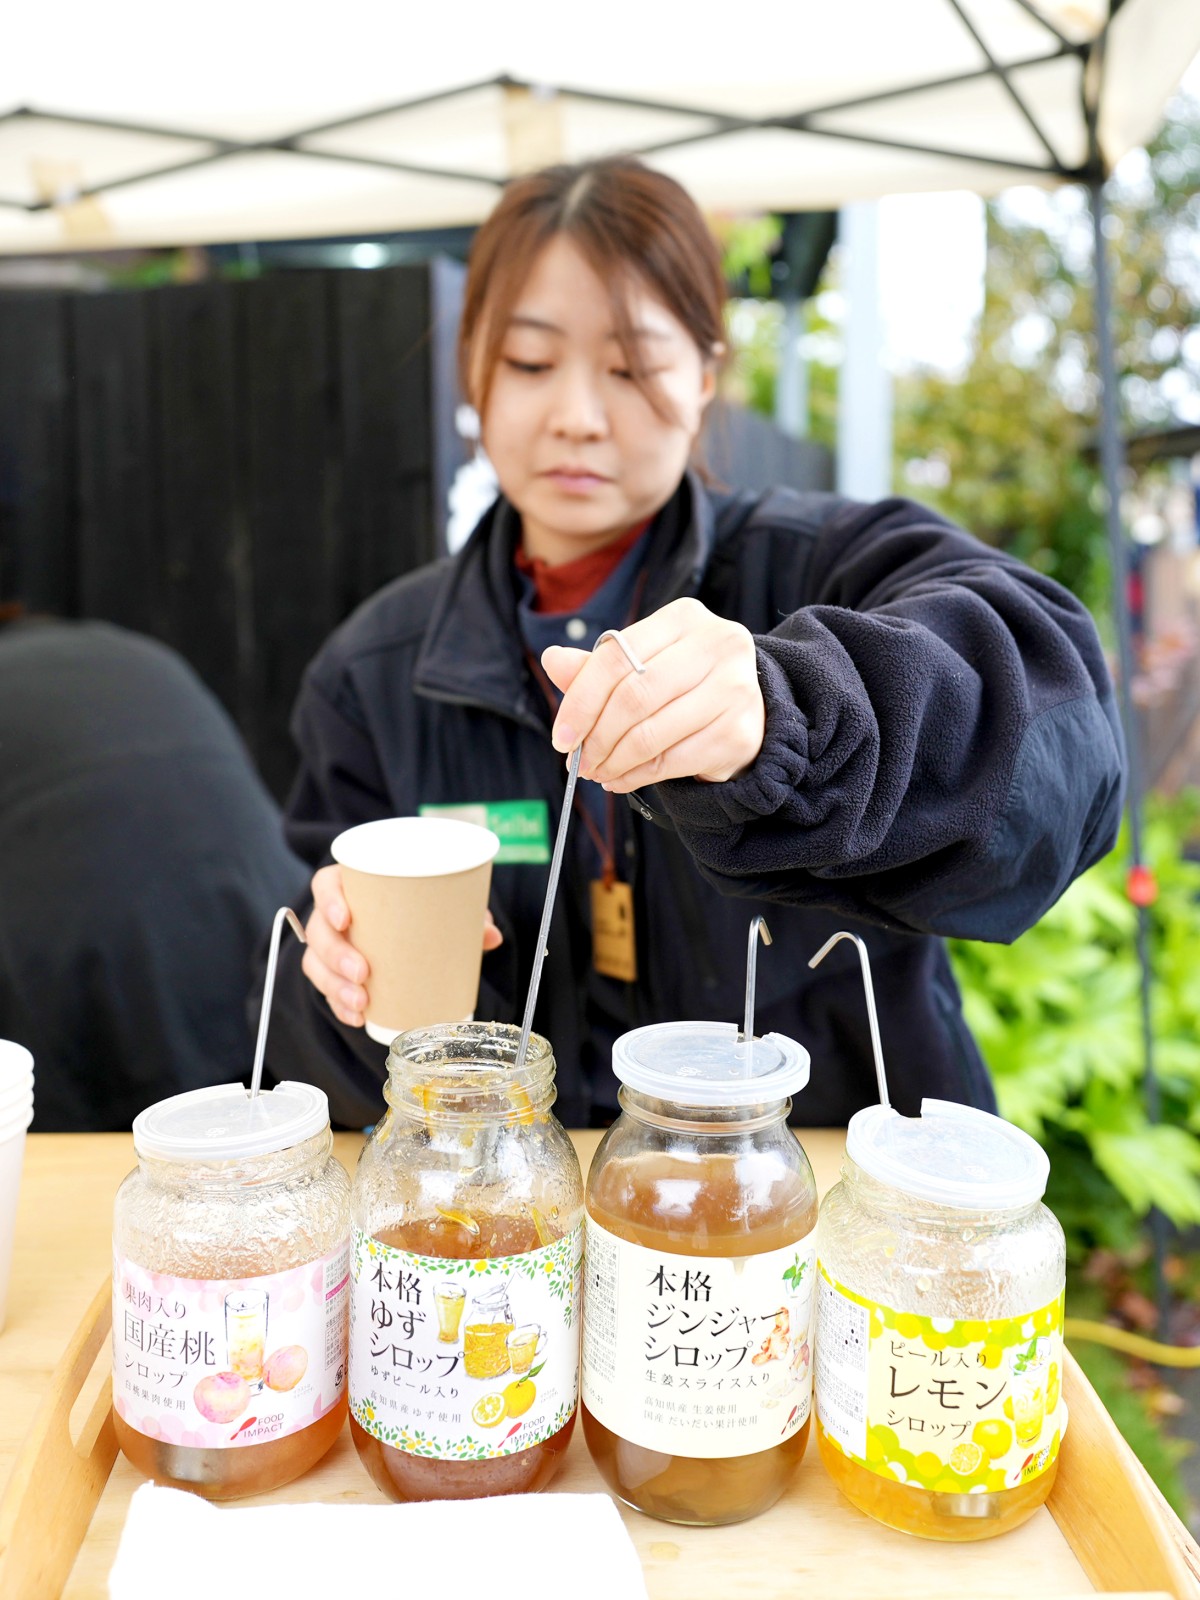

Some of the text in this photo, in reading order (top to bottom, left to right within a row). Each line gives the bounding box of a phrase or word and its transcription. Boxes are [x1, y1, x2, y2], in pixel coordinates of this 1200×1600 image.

[125, 1281, 187, 1320] 果肉入り
[370, 1262, 423, 1306] 本格
[646, 1264, 713, 1303] 本格
[370, 1299, 427, 1341] ゆず
[646, 1303, 785, 1338] ジンジャー
[124, 1310, 217, 1366] 国産桃
[644, 1335, 755, 1372] シロップ
[889, 1340, 988, 1369] ピール入り
[124, 1352, 188, 1389] シロップ
[369, 1333, 466, 1379] シロップ
[124, 1379, 188, 1412] 白桃果肉使用
[370, 1364, 460, 1400] ゆずピール入り
[644, 1369, 771, 1391] 生姜スライス入り
[888, 1365, 1008, 1411] レモン
[257, 1412, 286, 1428] FOOD
[369, 1389, 463, 1424] 高知県産ゆず使用
[522, 1414, 546, 1431] FOOD
[644, 1396, 738, 1415] 高知県産 生姜使用
[644, 1410, 665, 1424] 国産
[243, 1422, 285, 1439] IMPACT
[510, 1424, 546, 1445] IMPACT
[886, 1409, 973, 1441] シロップ
